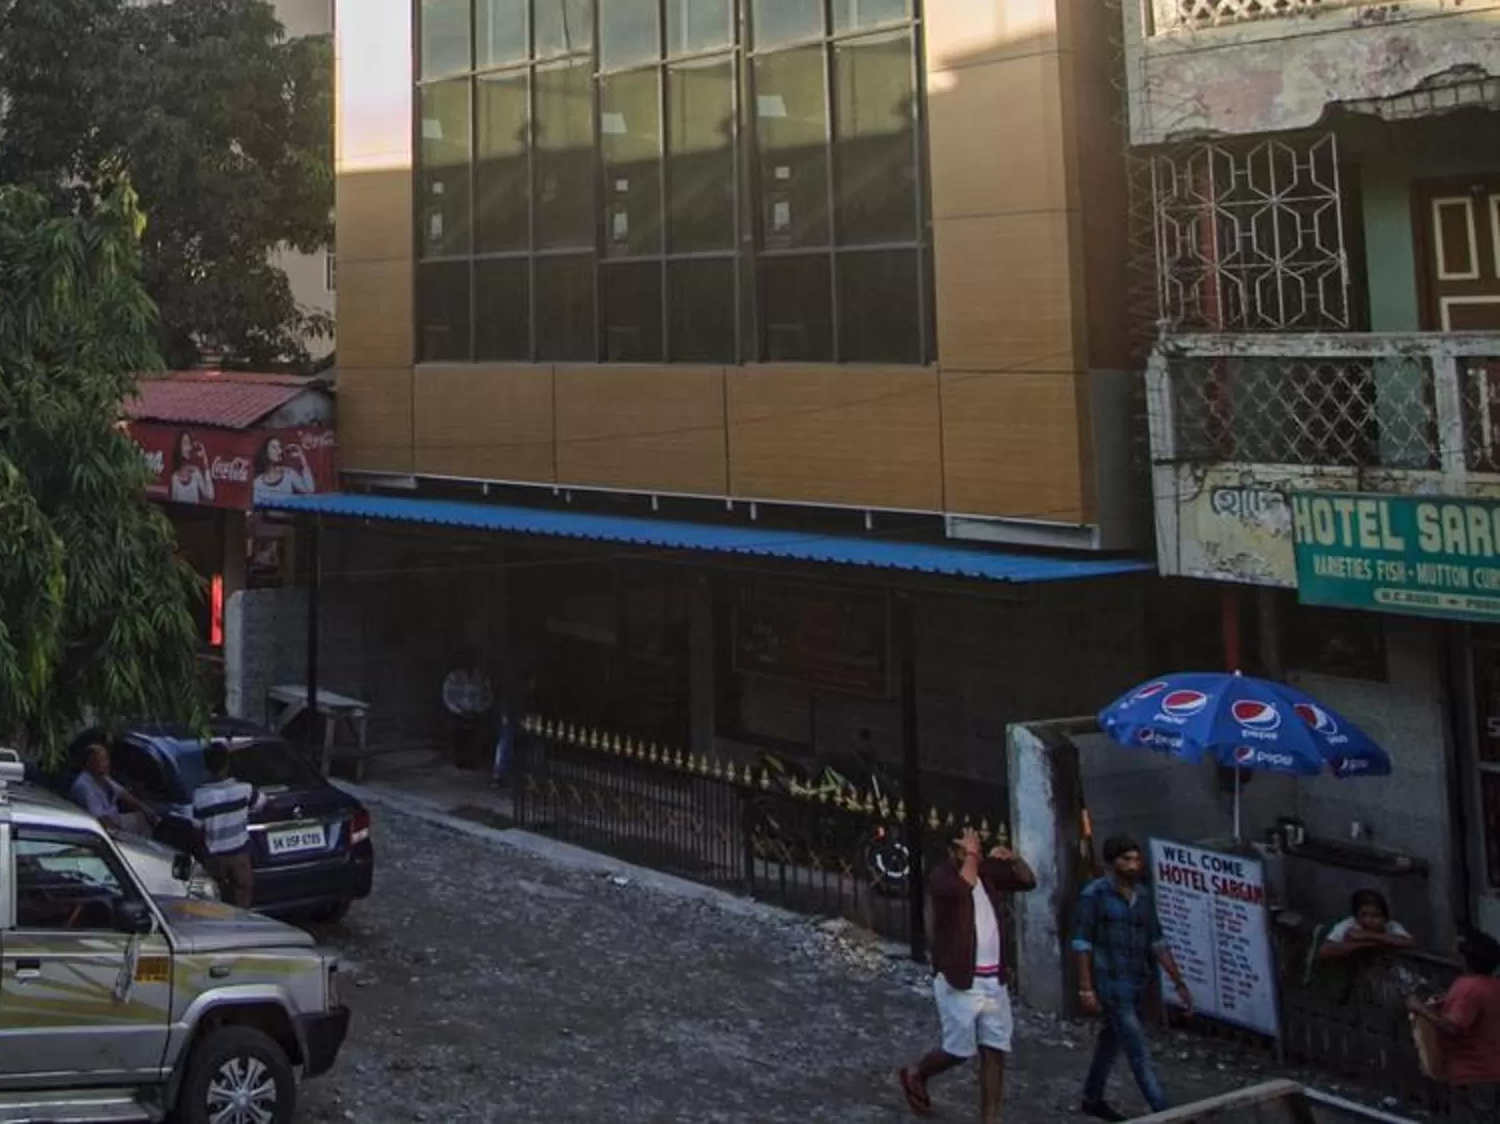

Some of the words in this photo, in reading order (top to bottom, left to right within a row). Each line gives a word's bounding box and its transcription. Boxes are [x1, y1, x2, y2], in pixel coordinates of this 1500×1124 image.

[1291, 494, 1406, 552] HOTEL
[1415, 562, 1470, 589] MUTTON
[1158, 862, 1209, 894] HOTEL
